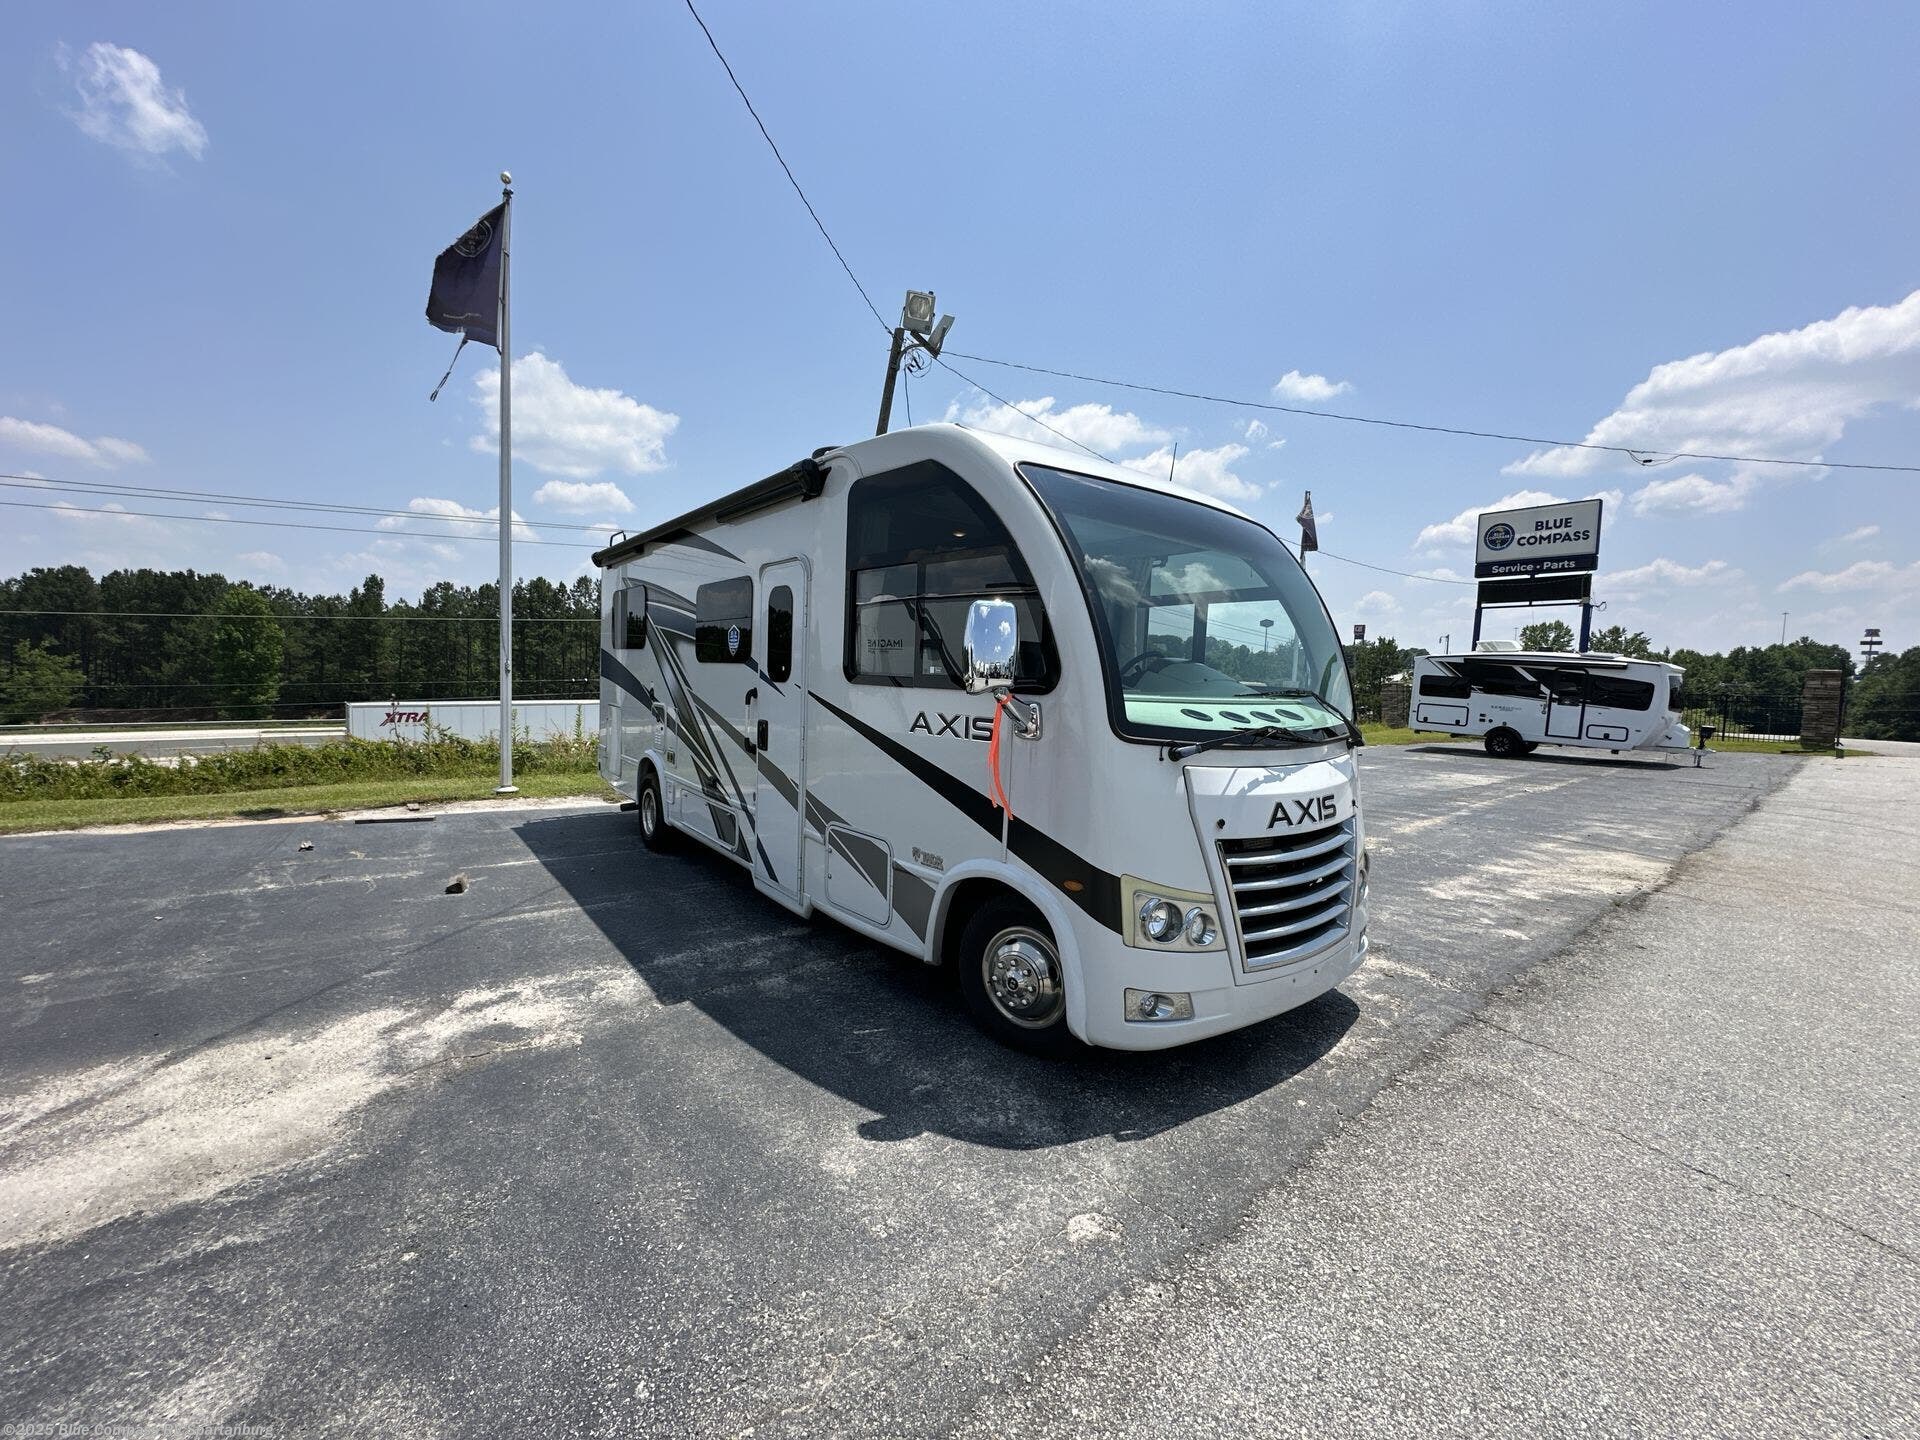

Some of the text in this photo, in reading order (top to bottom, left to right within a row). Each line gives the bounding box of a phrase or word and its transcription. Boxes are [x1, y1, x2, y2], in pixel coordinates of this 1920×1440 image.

[1535, 517, 1573, 531] BLUE
[1517, 530, 1590, 546] COMPASS
[1491, 560, 1576, 574] Service Parts
[909, 711, 993, 742] AXIS
[1267, 795, 1336, 830] AXIS
